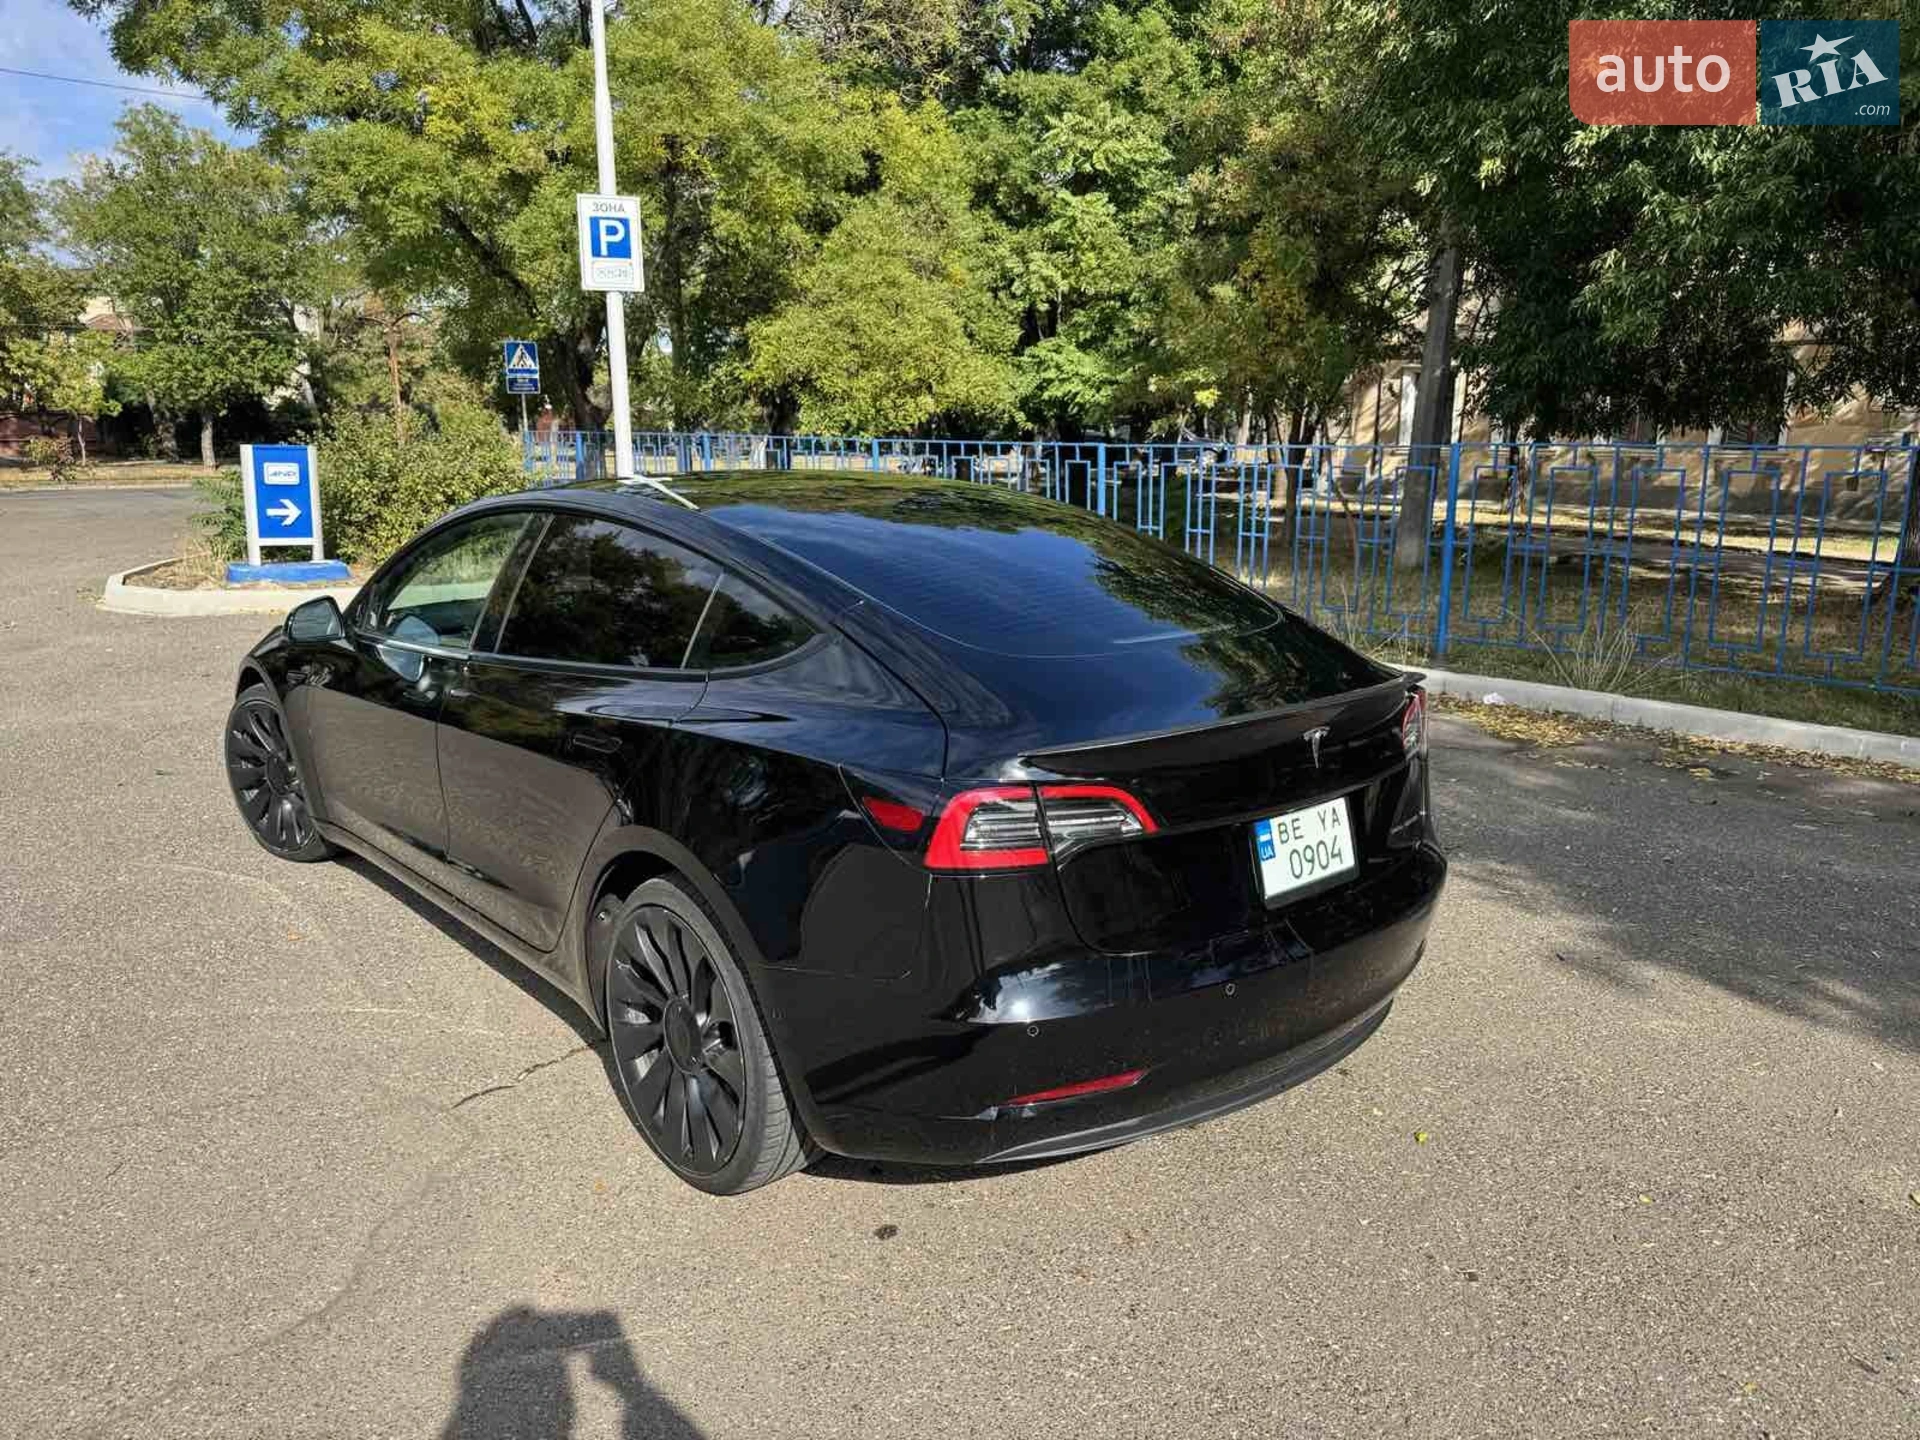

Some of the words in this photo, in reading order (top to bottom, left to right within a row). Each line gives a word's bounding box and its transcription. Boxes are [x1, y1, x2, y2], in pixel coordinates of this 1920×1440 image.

[592, 201, 625, 212] ЗОНА
[599, 218, 626, 256] P
[1277, 817, 1304, 844] BE
[1317, 806, 1341, 832] YA
[1260, 844, 1274, 858] UA
[1289, 835, 1344, 879] 0904
